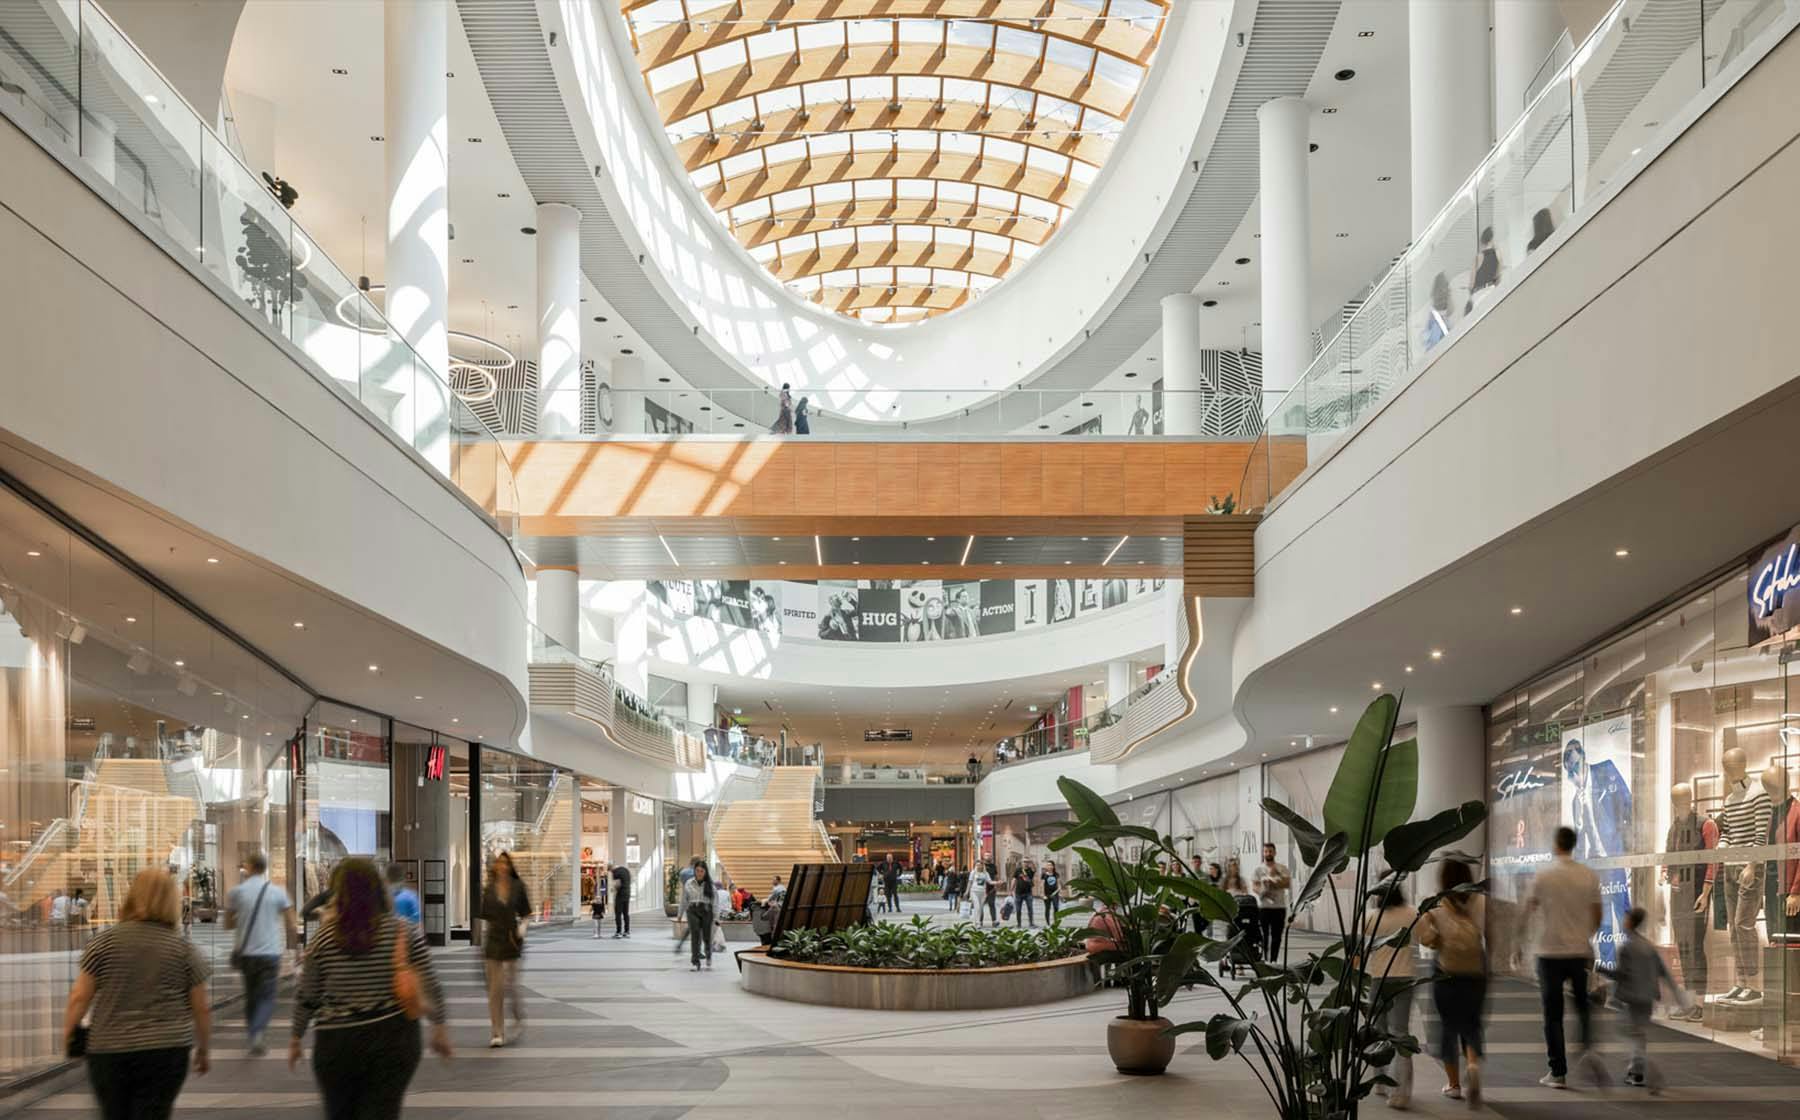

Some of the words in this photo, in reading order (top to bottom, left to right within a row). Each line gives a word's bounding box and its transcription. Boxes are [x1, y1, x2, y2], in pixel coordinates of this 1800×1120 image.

[784, 608, 816, 619] SPIRITED
[982, 603, 1014, 617] ACTION
[862, 612, 897, 626] HUG
